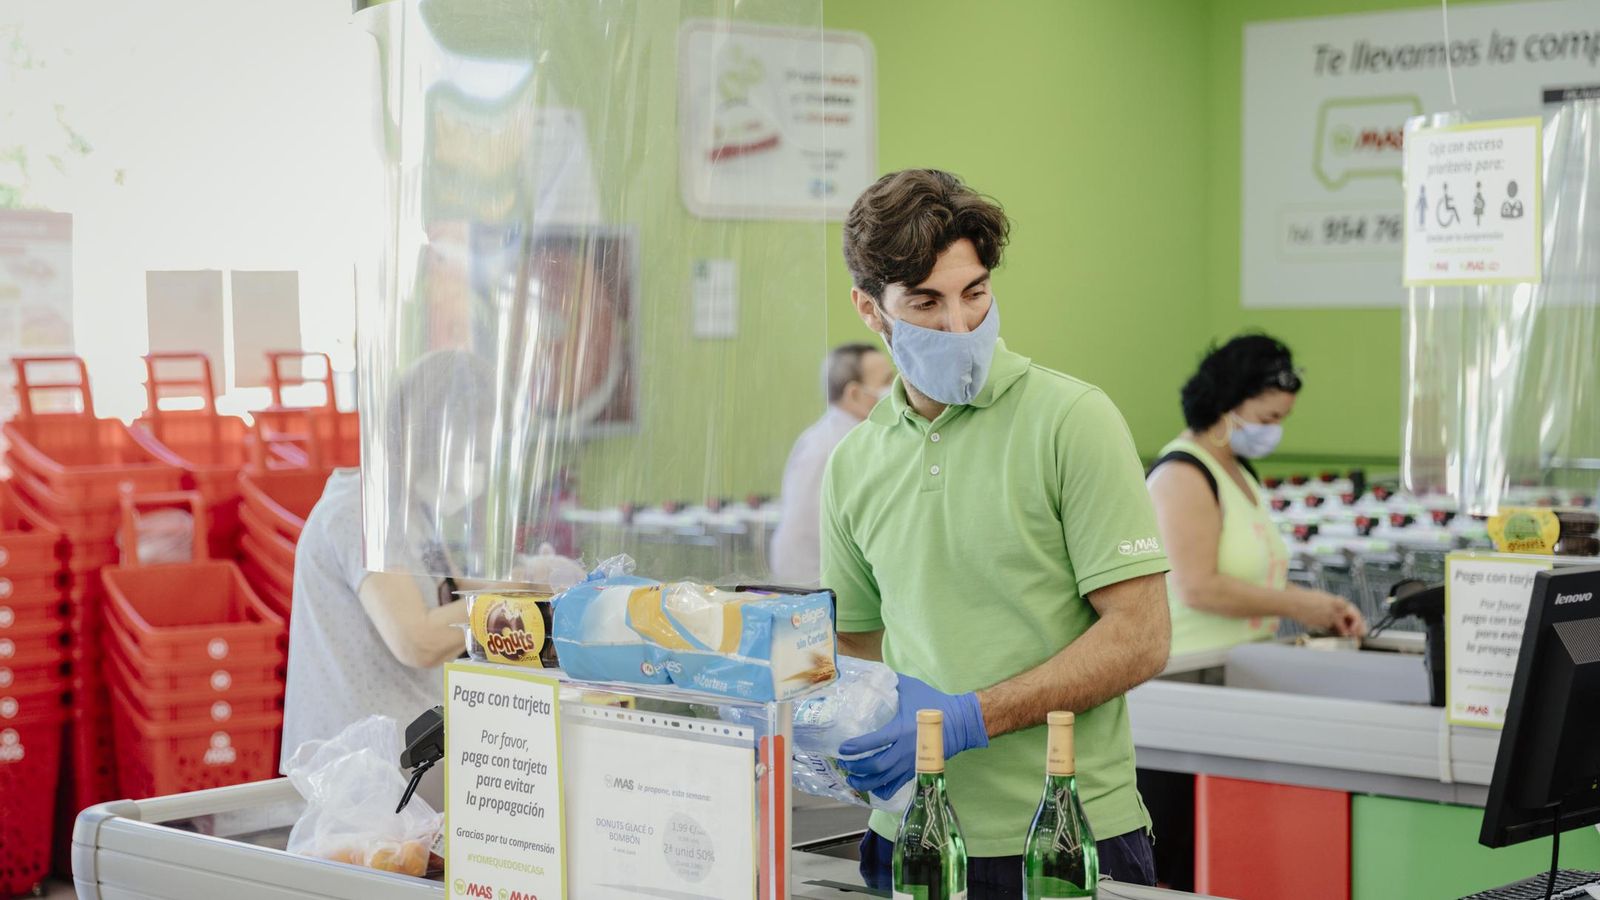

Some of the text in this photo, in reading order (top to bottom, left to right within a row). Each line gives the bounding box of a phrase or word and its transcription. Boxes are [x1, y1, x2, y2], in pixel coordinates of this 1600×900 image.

[1313, 43, 1346, 76] Te
[1351, 37, 1481, 74] llevamos
[1487, 29, 1517, 64] la
[1466, 138, 1503, 152] acceso
[1133, 537, 1159, 552] MAS
[1486, 572, 1506, 584] con
[1555, 592, 1593, 605] lenovo
[487, 630, 535, 656] donuts
[453, 685, 551, 717] Paga con tarjeta
[481, 729, 529, 753] Por favor,
[461, 751, 548, 777] paga con tarjeta
[476, 774, 535, 795] para evitar
[613, 777, 635, 791] MAS
[466, 790, 545, 819] la propagación
[596, 817, 625, 831] DONUTS
[456, 827, 556, 855] Gracias por tu comprensión
[675, 847, 695, 859] unid
[466, 883, 493, 900] MAS
